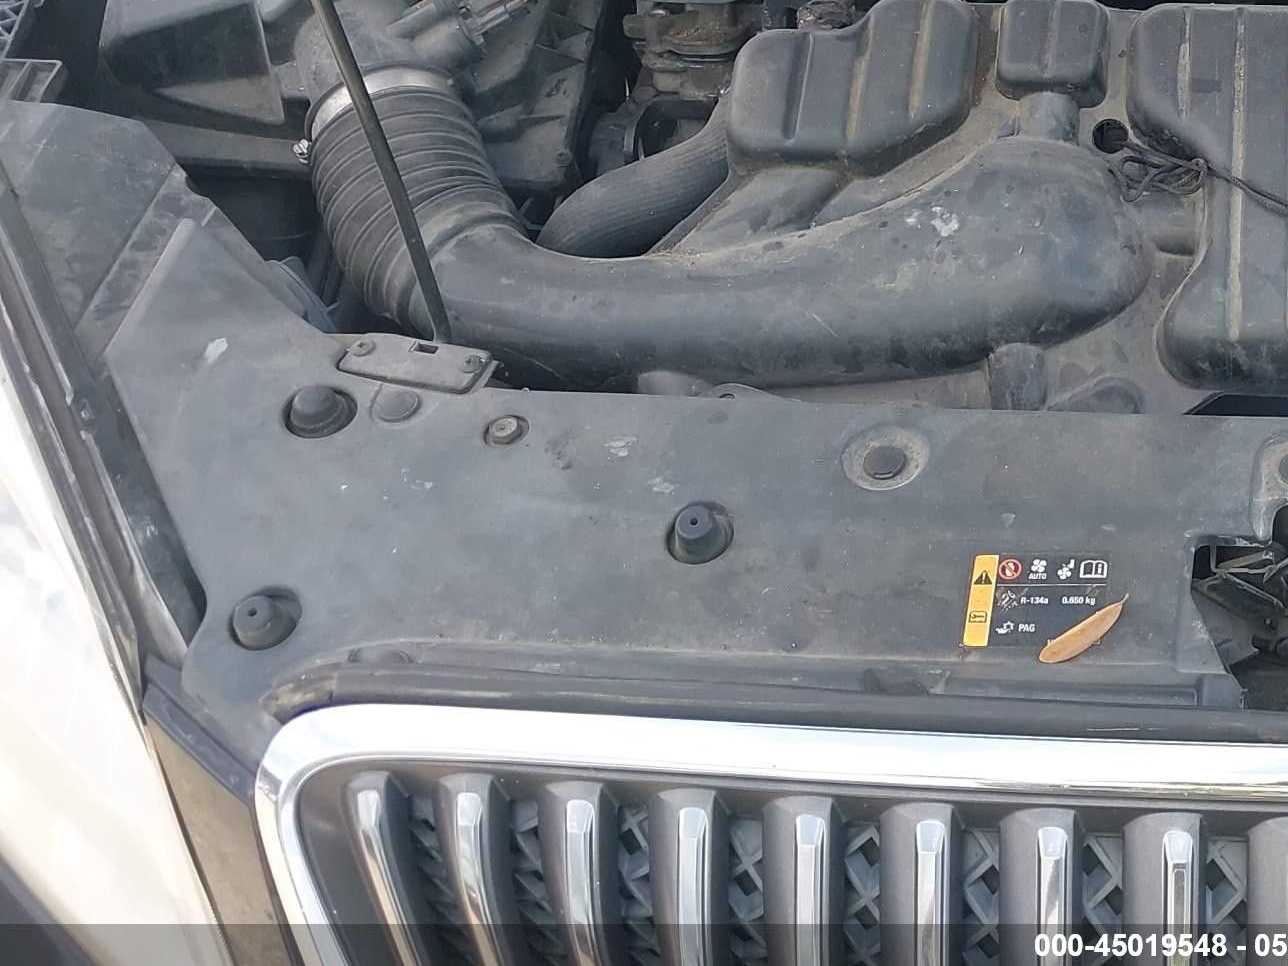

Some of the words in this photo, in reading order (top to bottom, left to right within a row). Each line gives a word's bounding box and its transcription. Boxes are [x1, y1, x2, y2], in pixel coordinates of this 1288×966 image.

[1028, 572, 1047, 580] AUTO
[1020, 596, 1049, 605] R-134a
[1062, 596, 1084, 605] 0.650
[1085, 596, 1096, 606] kg
[1018, 623, 1036, 633] PAG
